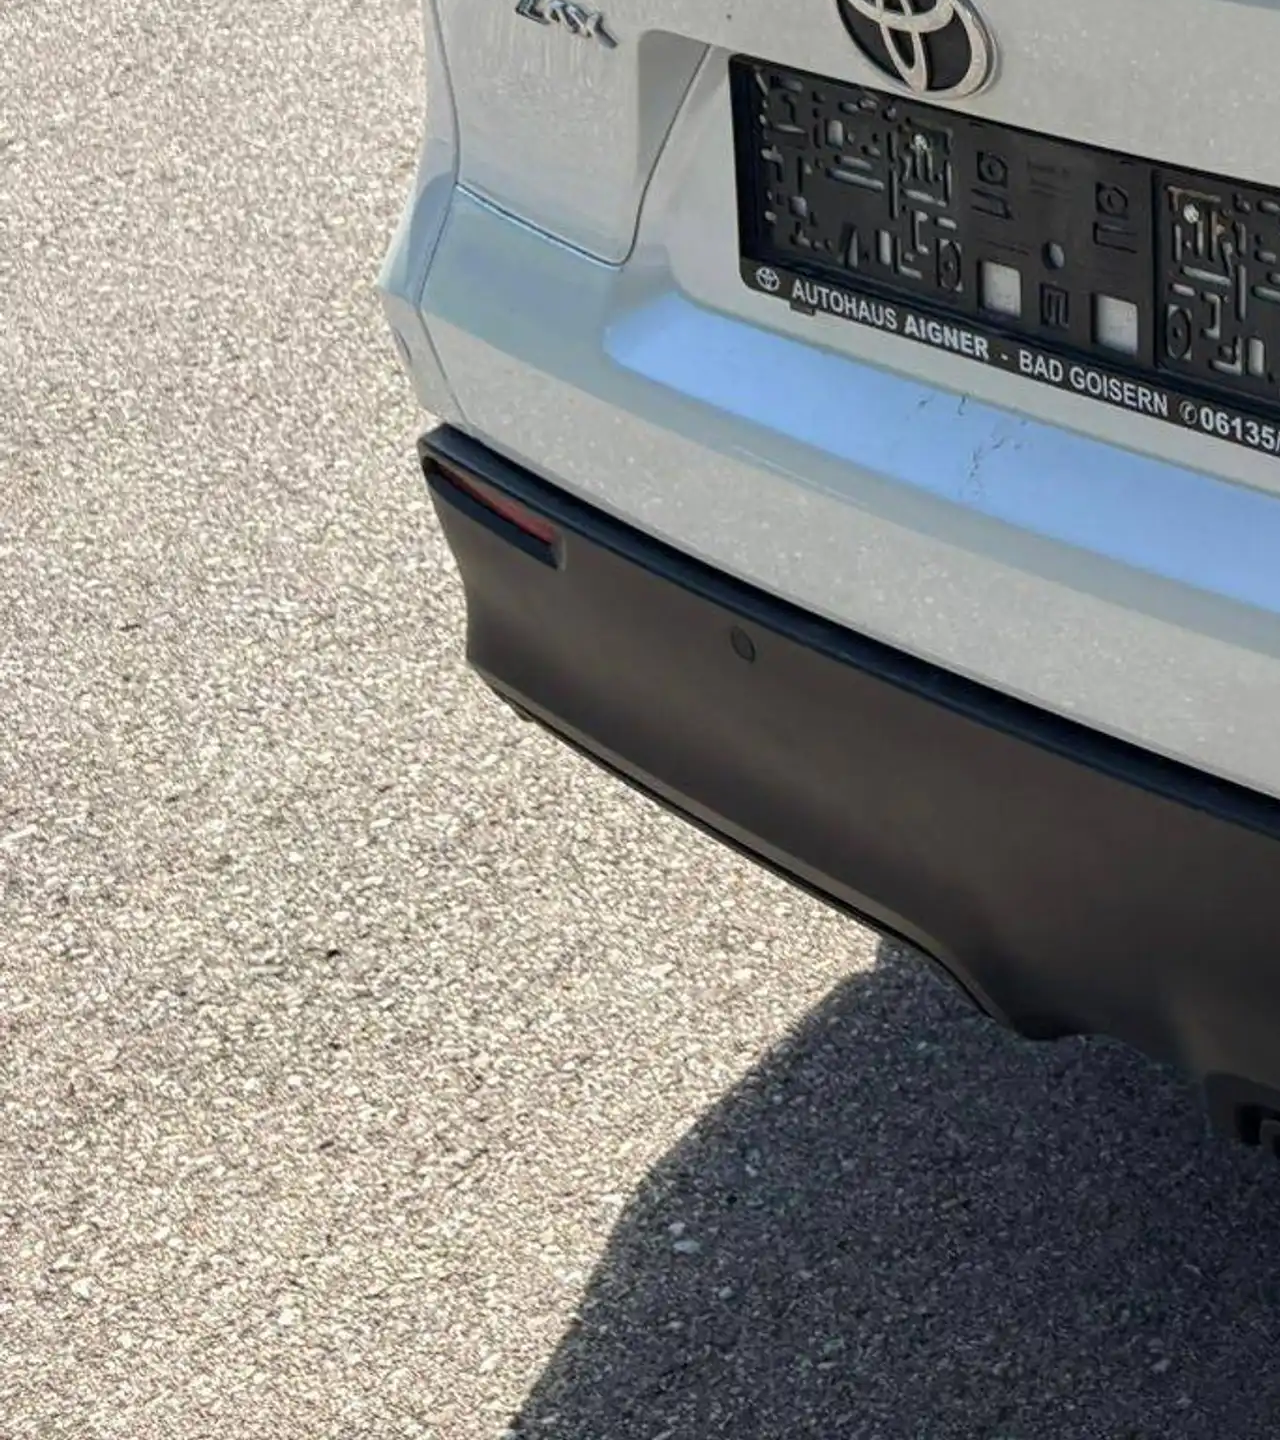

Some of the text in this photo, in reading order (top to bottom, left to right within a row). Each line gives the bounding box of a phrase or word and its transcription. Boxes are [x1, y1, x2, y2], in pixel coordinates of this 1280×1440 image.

[791, 278, 898, 330] AUTOHAUS
[904, 314, 990, 361] AIGNER
[1018, 348, 1064, 383] BAD
[1069, 365, 1169, 418] GOISERN
